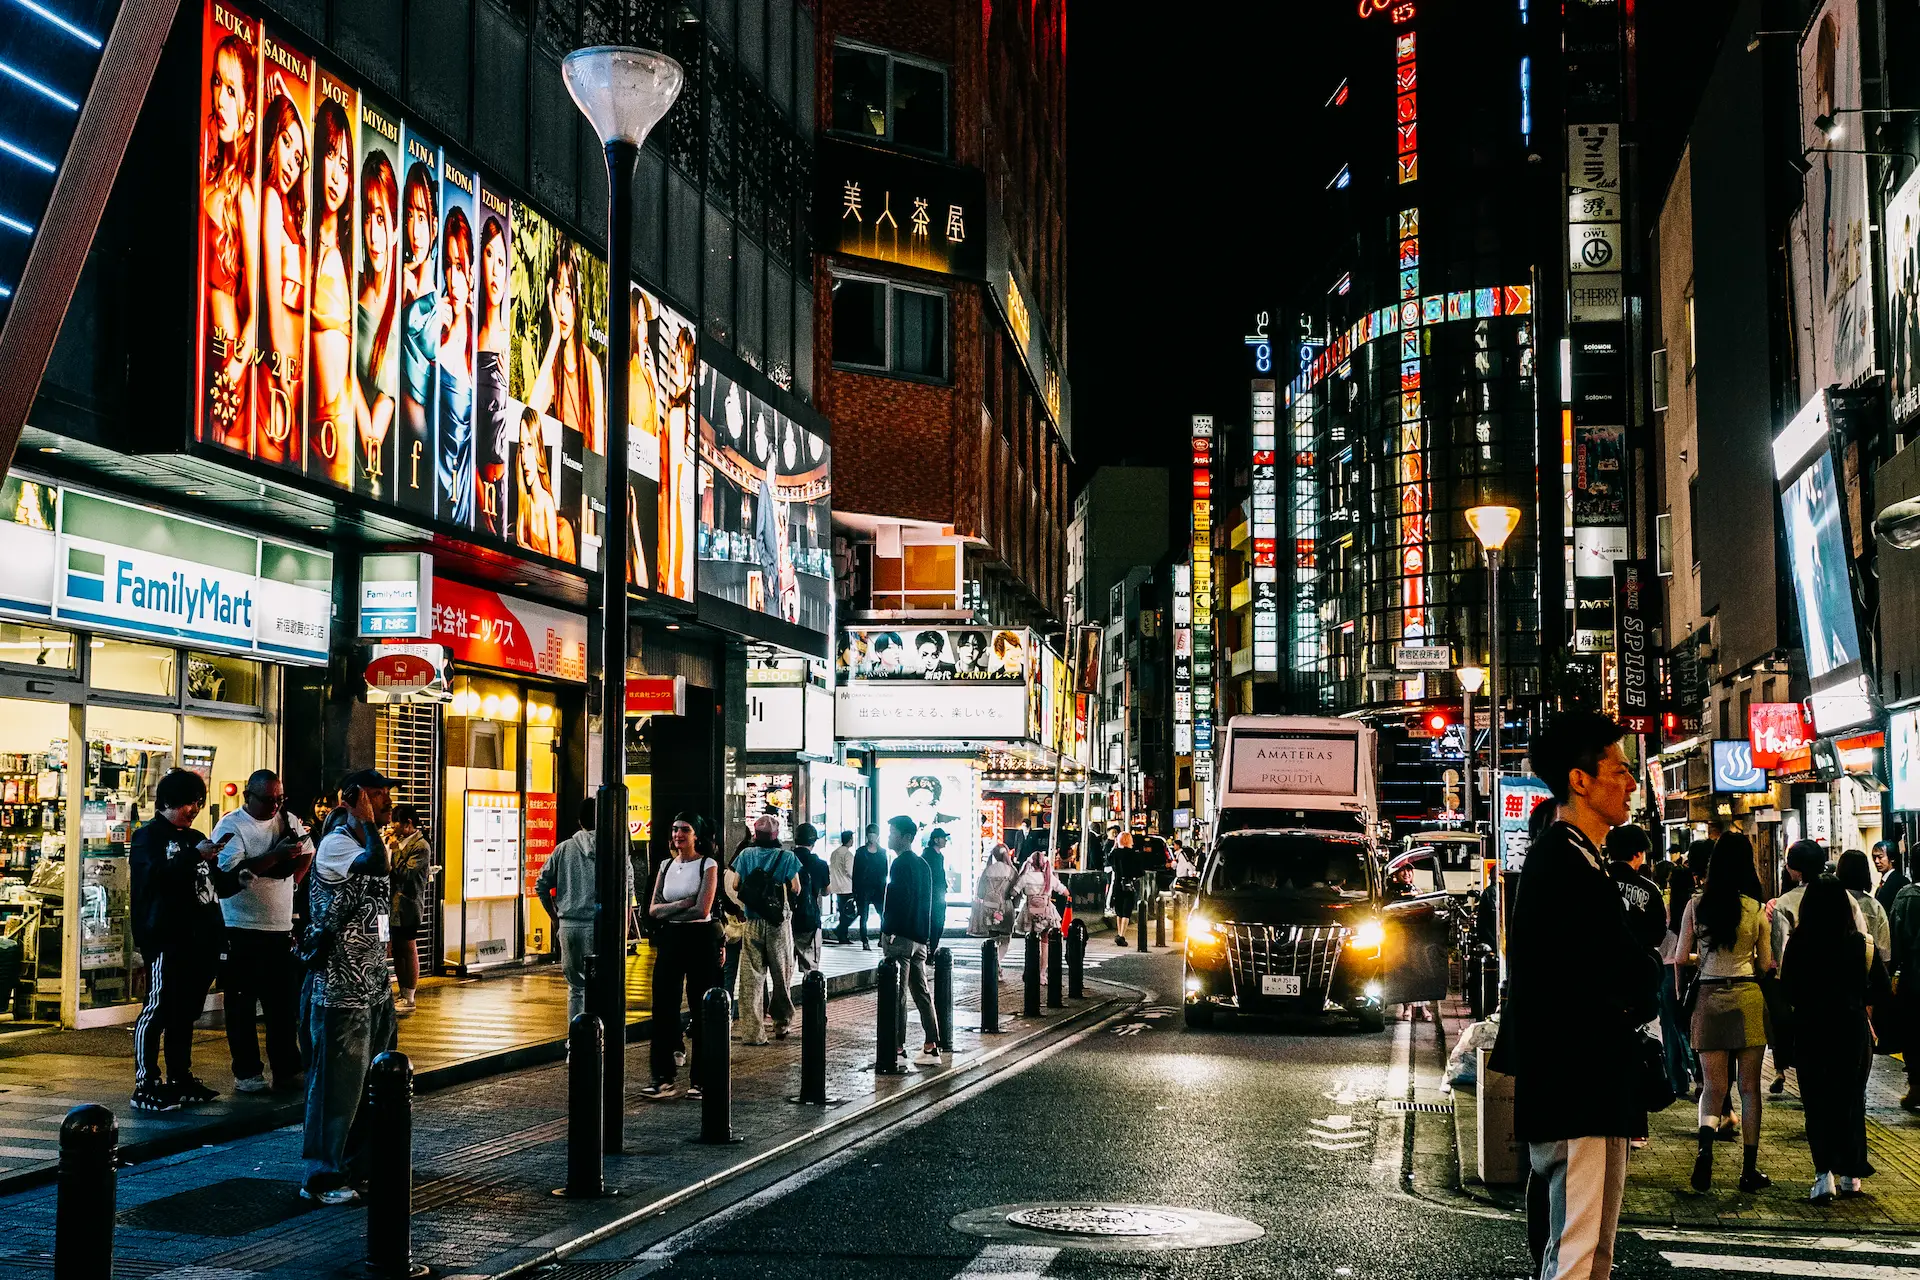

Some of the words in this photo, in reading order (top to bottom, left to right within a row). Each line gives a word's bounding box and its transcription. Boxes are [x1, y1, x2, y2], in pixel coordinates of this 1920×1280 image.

[214, 3, 253, 44] RUKA
[264, 38, 308, 83] SARINA
[321, 77, 349, 110] MOE
[362, 105, 398, 144] MIYABI
[408, 138, 435, 169] AINA
[445, 162, 474, 195] RIONA
[481, 188, 507, 217] IZUMI
[843, 180, 966, 242] 美人茶屋
[1583, 230, 1608, 238] OWL
[1573, 288, 1619, 299] CHERRY
[213, 325, 265, 365] 当ビル
[271, 350, 299, 383] 2F
[116, 559, 252, 628] FamilyMart
[366, 590, 412, 598] FamilyMart
[370, 617, 382, 631] 酒
[385, 618, 408, 629] たばこ
[1399, 649, 1447, 660] 新宿区役所通り
[1623, 615, 1646, 707] SPIRE
[954, 671, 993, 680] #CANDY
[629, 691, 671, 699] 株式会社ニックス
[1256, 748, 1333, 760] AMATERAS
[1817, 799, 1825, 833] 上海小吃
[1286, 984, 1298, 994] 58
